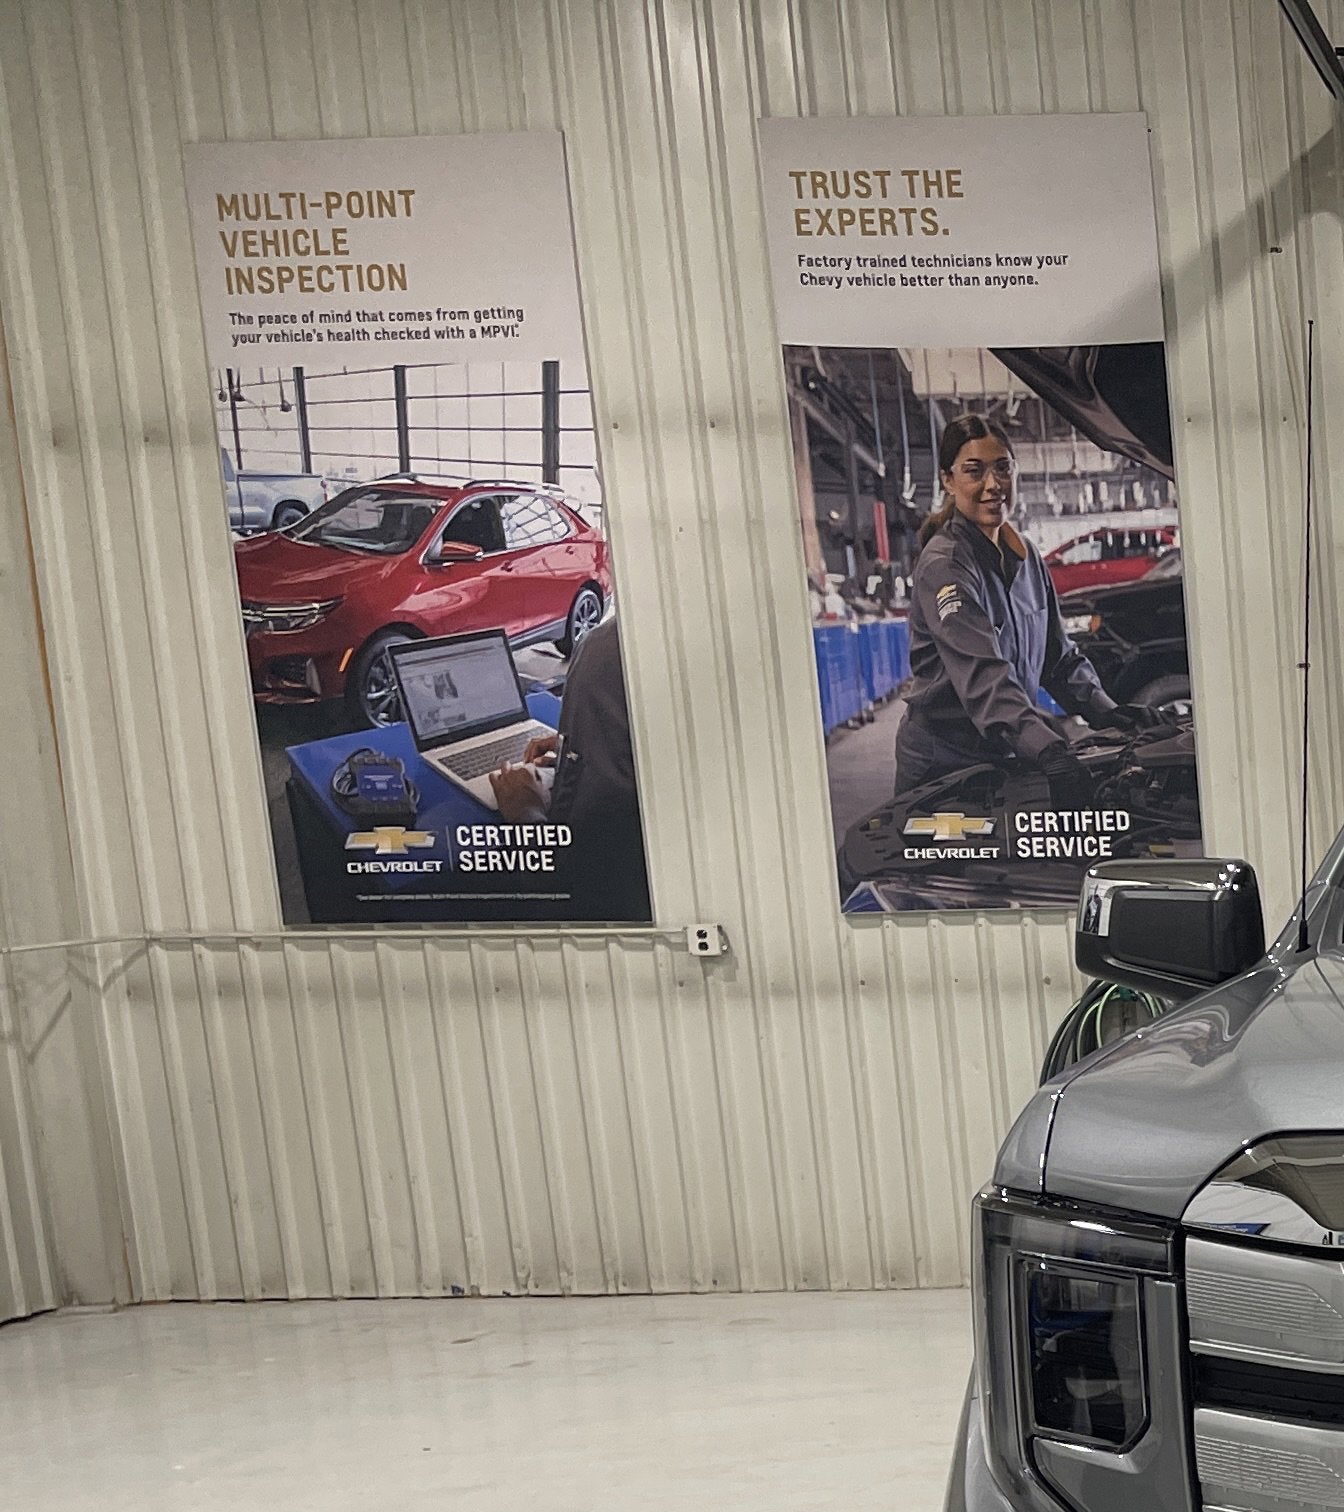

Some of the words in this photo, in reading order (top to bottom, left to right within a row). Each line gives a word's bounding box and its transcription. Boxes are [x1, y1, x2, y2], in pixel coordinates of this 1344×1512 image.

[789, 170, 891, 200] TRUST
[901, 169, 964, 198] THE
[216, 190, 415, 221] MULTI-POINT
[794, 207, 950, 237] EXPERTS.
[219, 228, 350, 258] VEHICLE
[797, 254, 852, 271] Factory
[856, 254, 907, 268] trained
[911, 253, 992, 268] technicians
[995, 253, 1033, 267] know
[1036, 255, 1069, 270] your
[225, 263, 408, 295] INSPECTION
[799, 272, 843, 290] Chevy
[847, 273, 896, 287] vehicle
[900, 273, 944, 287] better
[948, 273, 980, 287] than
[984, 274, 1039, 290] anyone.
[229, 312, 254, 326] The
[258, 314, 298, 329] peace
[301, 310, 314, 324] of
[318, 309, 352, 324] mind
[355, 310, 386, 323] that
[388, 311, 433, 322] comes
[436, 307, 470, 321] from
[473, 306, 524, 323] getting
[231, 333, 262, 348] your
[265, 328, 324, 343] vehicle's
[326, 328, 371, 342] health
[373, 326, 431, 341] checked
[433, 325, 465, 340] with
[468, 328, 477, 339] a
[1014, 810, 1131, 833] CERTIFIED
[456, 825, 573, 847] CERTIFIED
[1016, 836, 1113, 858] SERVICE
[458, 850, 556, 872] SERVICE
[903, 847, 1000, 860] CHEVROLET
[346, 860, 444, 874] CHEVROLET
